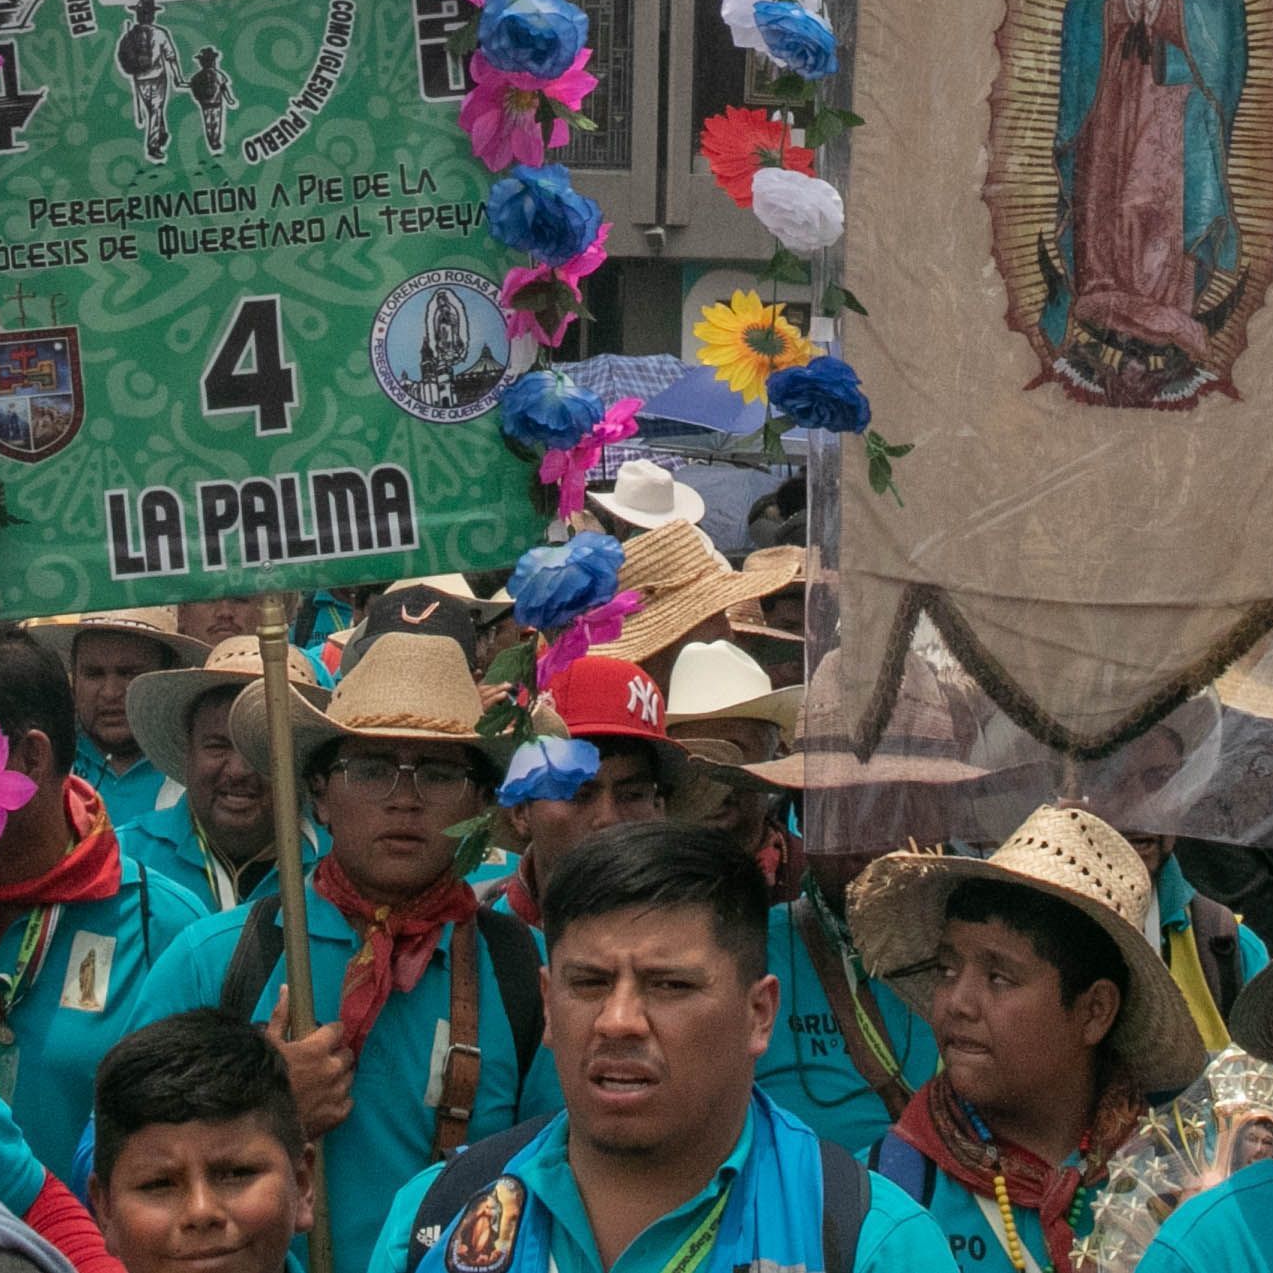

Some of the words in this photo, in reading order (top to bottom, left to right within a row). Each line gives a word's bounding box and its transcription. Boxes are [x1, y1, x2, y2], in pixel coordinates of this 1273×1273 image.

[328, 0, 353, 47] COMO
[292, 47, 342, 112] IGLESIA,
[245, 108, 306, 161] PUEBLO
[271, 183, 290, 208] A
[298, 174, 343, 205] PIE
[353, 173, 391, 200] DE
[399, 164, 436, 195] LA
[99, 235, 138, 262] DE
[335, 206, 371, 240] AL
[379, 200, 489, 237] TEPEYA
[378, 271, 442, 325] FLORENCIO
[444, 271, 490, 293] ROSAS
[203, 297, 297, 433] 4
[373, 337, 406, 403] PEREGRINOS
[405, 399, 415, 410] A
[413, 402, 429, 418] PIE
[431, 409, 447, 419] DE
[108, 488, 186, 576] LA
[199, 465, 416, 568] PALMA
